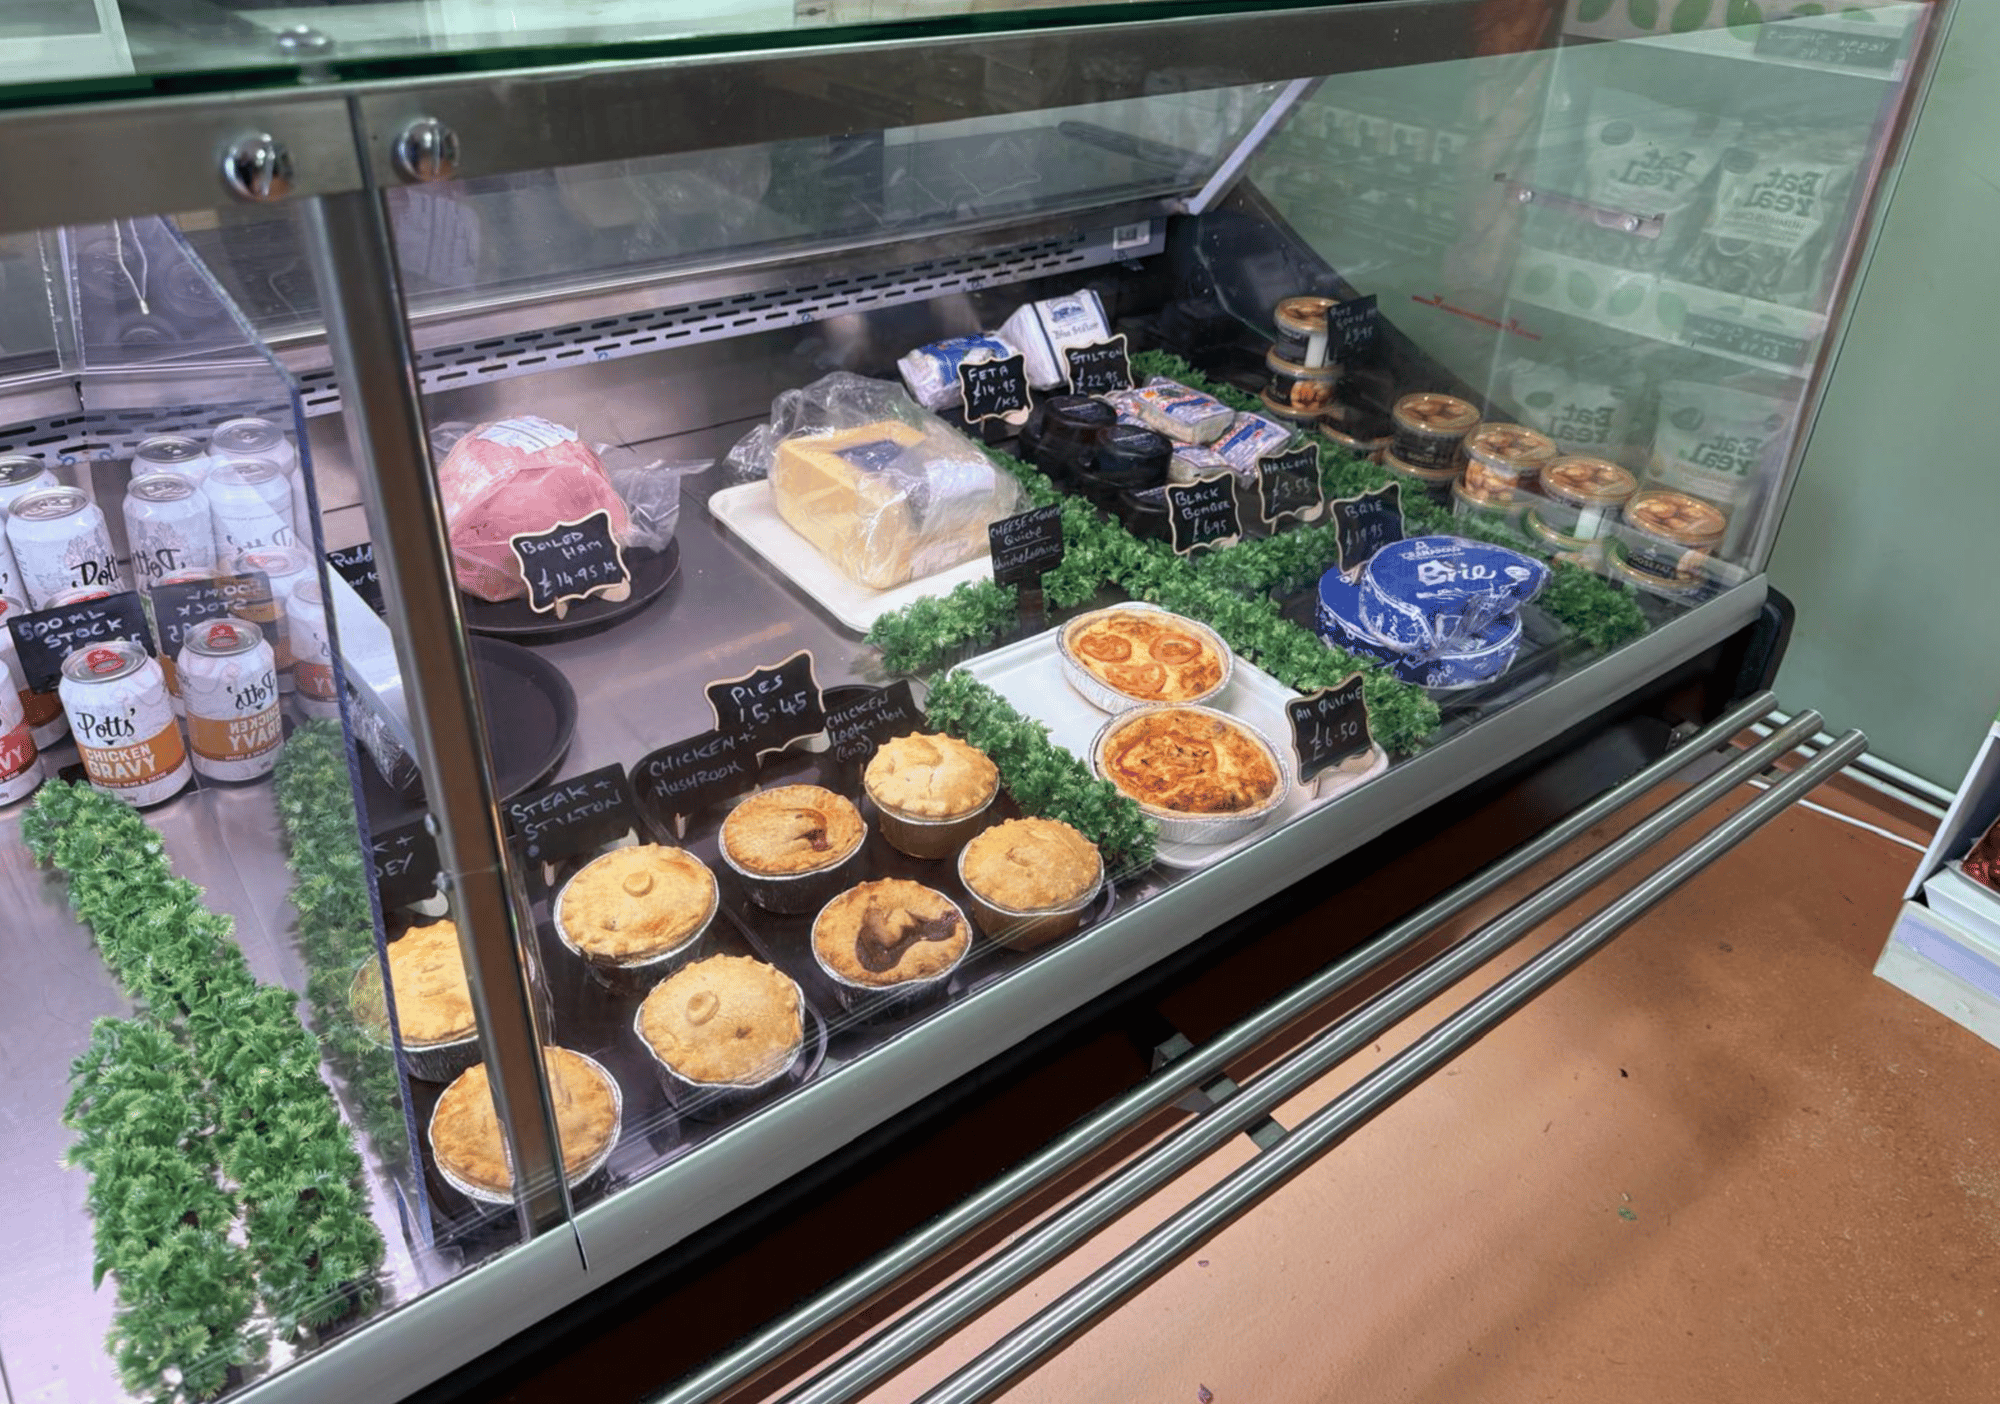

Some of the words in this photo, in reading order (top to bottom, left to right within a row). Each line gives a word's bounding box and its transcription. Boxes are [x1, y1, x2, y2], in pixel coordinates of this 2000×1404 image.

[1070, 348, 1124, 365] STILTON
[968, 365, 1009, 382] FETA
[972, 379, 1016, 406] £14.95
[1175, 487, 1219, 506] BLACK
[1181, 500, 1231, 520] BOMBER
[1344, 500, 1383, 519] BRIE
[519, 532, 584, 555] BOILED
[538, 565, 598, 598] £14.95
[1418, 561, 1497, 586] Brie
[18, 617, 63, 641] 500
[44, 617, 122, 649] STOCK
[730, 674, 783, 706] PIES
[1318, 686, 1363, 718] QUICHE
[74, 707, 136, 740] Potts'
[826, 690, 890, 729] CHICKEN
[86, 742, 151, 764] CHICKEN
[1309, 721, 1358, 761] £6.50
[88, 753, 157, 780] GRAVY
[650, 736, 736, 777] CHICKEN
[655, 761, 745, 798] MUSHROOM
[511, 784, 589, 823] STEAK
[524, 788, 623, 841] STILTON
